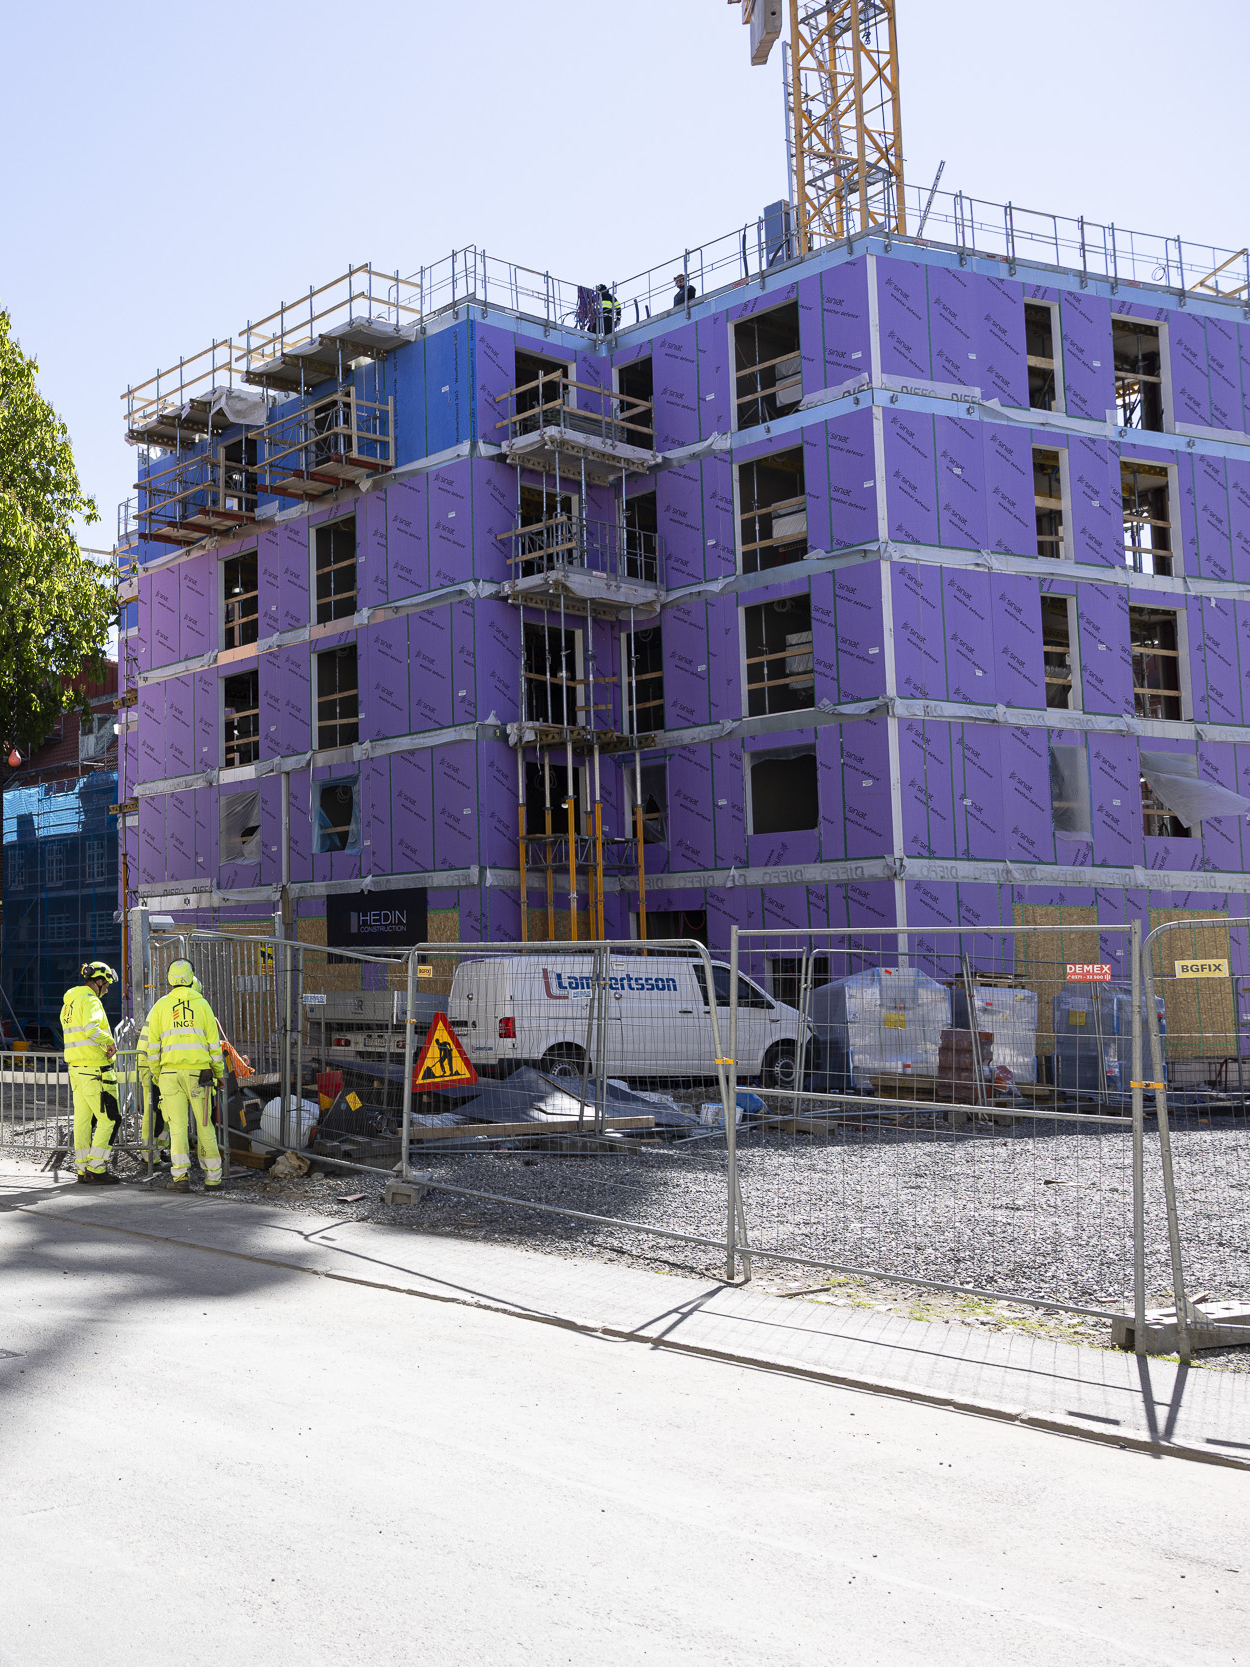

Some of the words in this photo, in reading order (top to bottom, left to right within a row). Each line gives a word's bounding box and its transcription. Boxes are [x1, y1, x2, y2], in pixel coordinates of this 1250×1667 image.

[893, 285, 910, 300] siniat
[825, 297, 844, 307] siniat
[941, 304, 958, 319] siniat
[991, 320, 1008, 336] siniat
[667, 343, 683, 352] siniat
[896, 336, 912, 353] siniat
[1070, 339, 1085, 355] siniat
[828, 349, 846, 358] siniat
[994, 372, 1010, 387] siniat
[668, 391, 684, 400] siniat
[830, 433, 849, 444] siniat
[898, 423, 915, 439] siniat
[997, 440, 1014, 456] siniat
[832, 486, 851, 497] siniat
[901, 477, 918, 493] siniat
[1000, 492, 1017, 509] siniat
[672, 508, 687, 519] siniat
[951, 510, 968, 526] siniat
[674, 556, 689, 567] siniat
[837, 583, 856, 595] siniat
[906, 574, 924, 590] siniat
[956, 585, 972, 601] siniat
[1006, 599, 1023, 615] siniat
[840, 637, 859, 649] siniat
[909, 628, 926, 644] siniat
[677, 655, 693, 666] siniat
[1009, 652, 1026, 668] siniat
[845, 751, 864, 764] siniat
[1101, 756, 1117, 772] siniat
[1016, 777, 1033, 793] siniat
[682, 794, 698, 806] siniat
[847, 806, 867, 820] siniat
[1104, 810, 1120, 826] siniat
[849, 885, 869, 899] siniat
[922, 888, 940, 904] siniat
[767, 897, 785, 911] siniat
[360, 910, 407, 925] HEDIN
[360, 925, 407, 933] CONSTRUCTION
[1066, 964, 1110, 973] DEMEX
[1181, 963, 1223, 973] BGFIX
[173, 1020, 194, 1028] ING3
